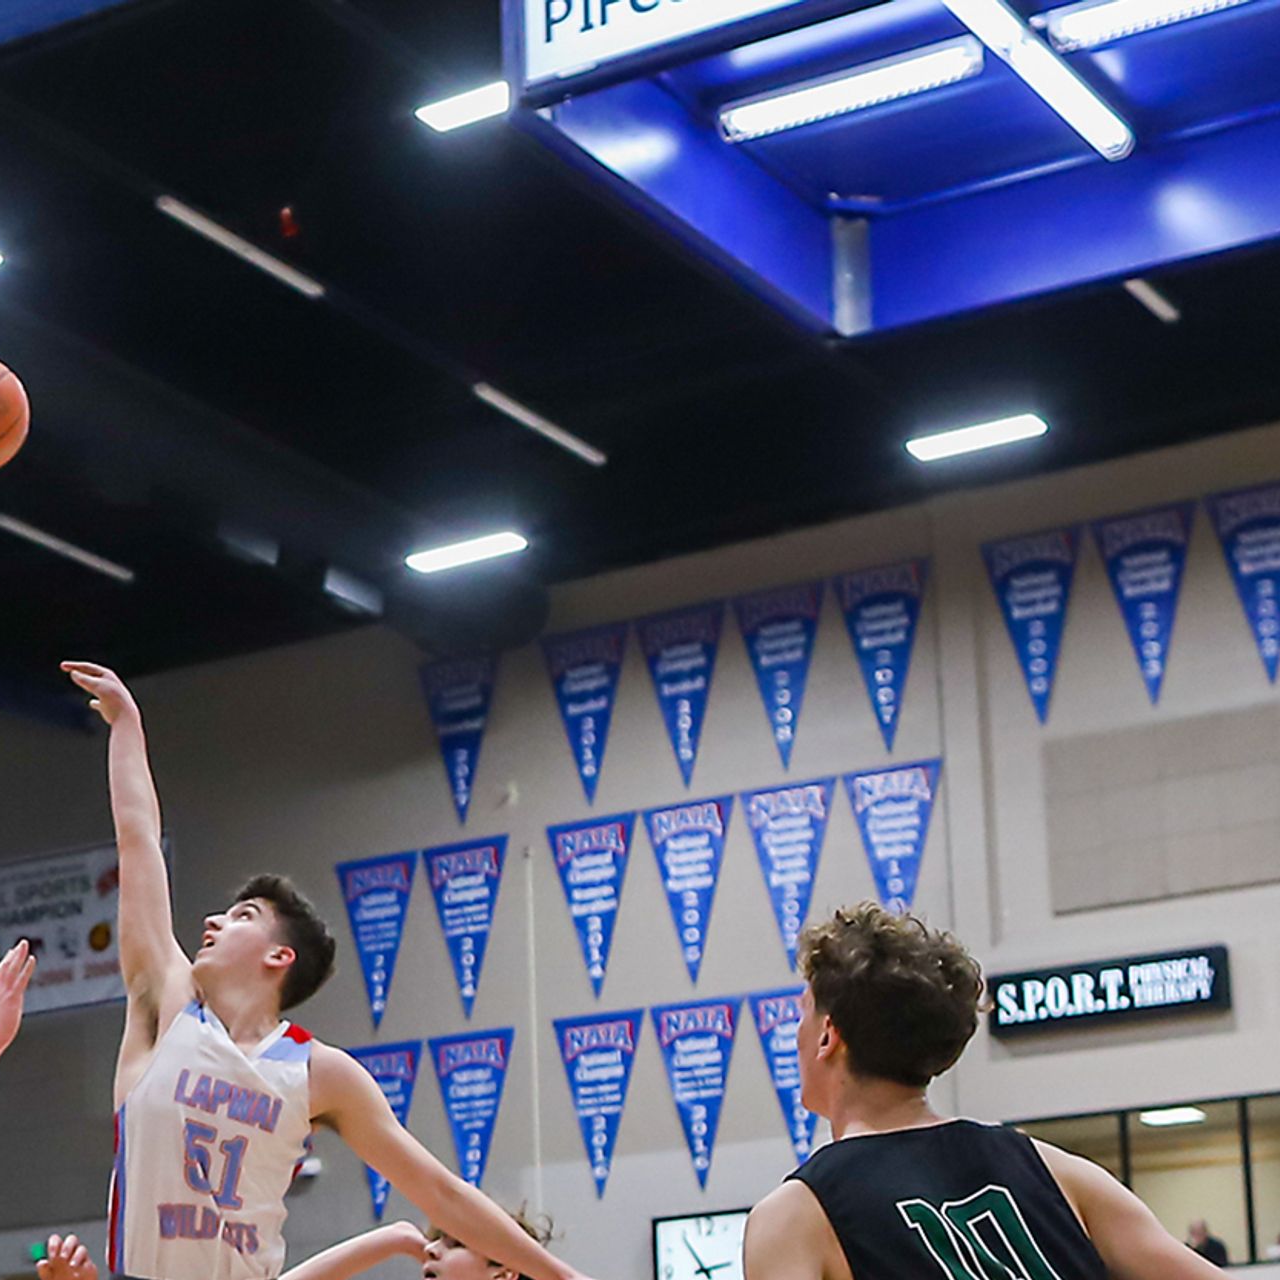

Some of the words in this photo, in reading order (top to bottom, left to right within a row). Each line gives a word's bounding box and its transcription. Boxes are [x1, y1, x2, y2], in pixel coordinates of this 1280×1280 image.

[750, 784, 826, 830] NAIA
[853, 766, 932, 814] NAIA
[556, 822, 627, 866] NAIA
[651, 801, 724, 846] NAIA
[13, 873, 92, 901] SPORTS
[431, 845, 498, 889] NAIA
[996, 968, 1131, 1026] S.P.O.R.T.
[1128, 955, 1211, 987] PHYSICAL
[564, 1019, 635, 1063] NAIA
[660, 1003, 735, 1048] NAIA
[439, 1037, 506, 1078] NAIA
[174, 1068, 283, 1134] LAPWAI
[184, 1117, 249, 1211] 51
[695, 1216, 715, 1237] 12
